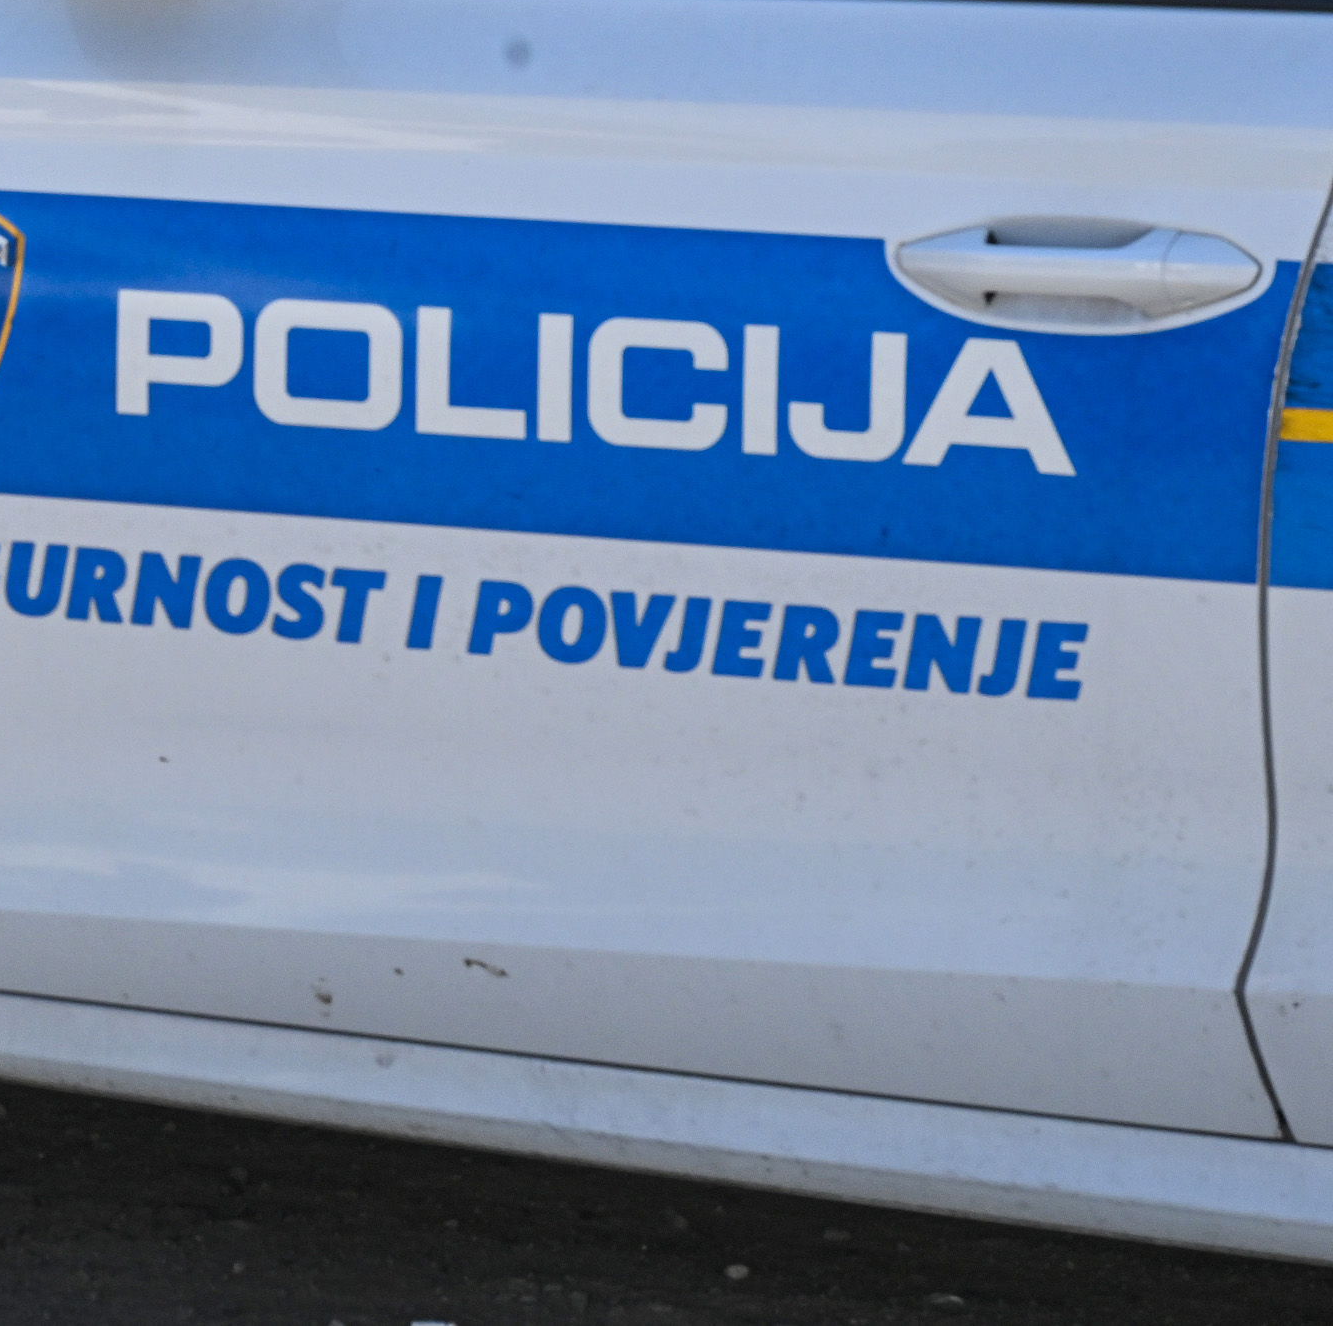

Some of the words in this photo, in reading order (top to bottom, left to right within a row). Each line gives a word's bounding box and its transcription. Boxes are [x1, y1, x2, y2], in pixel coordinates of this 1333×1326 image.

[116, 289, 1076, 477] POLICIJA
[406, 575, 443, 650] I
[467, 580, 1089, 701] POVJERENJE
